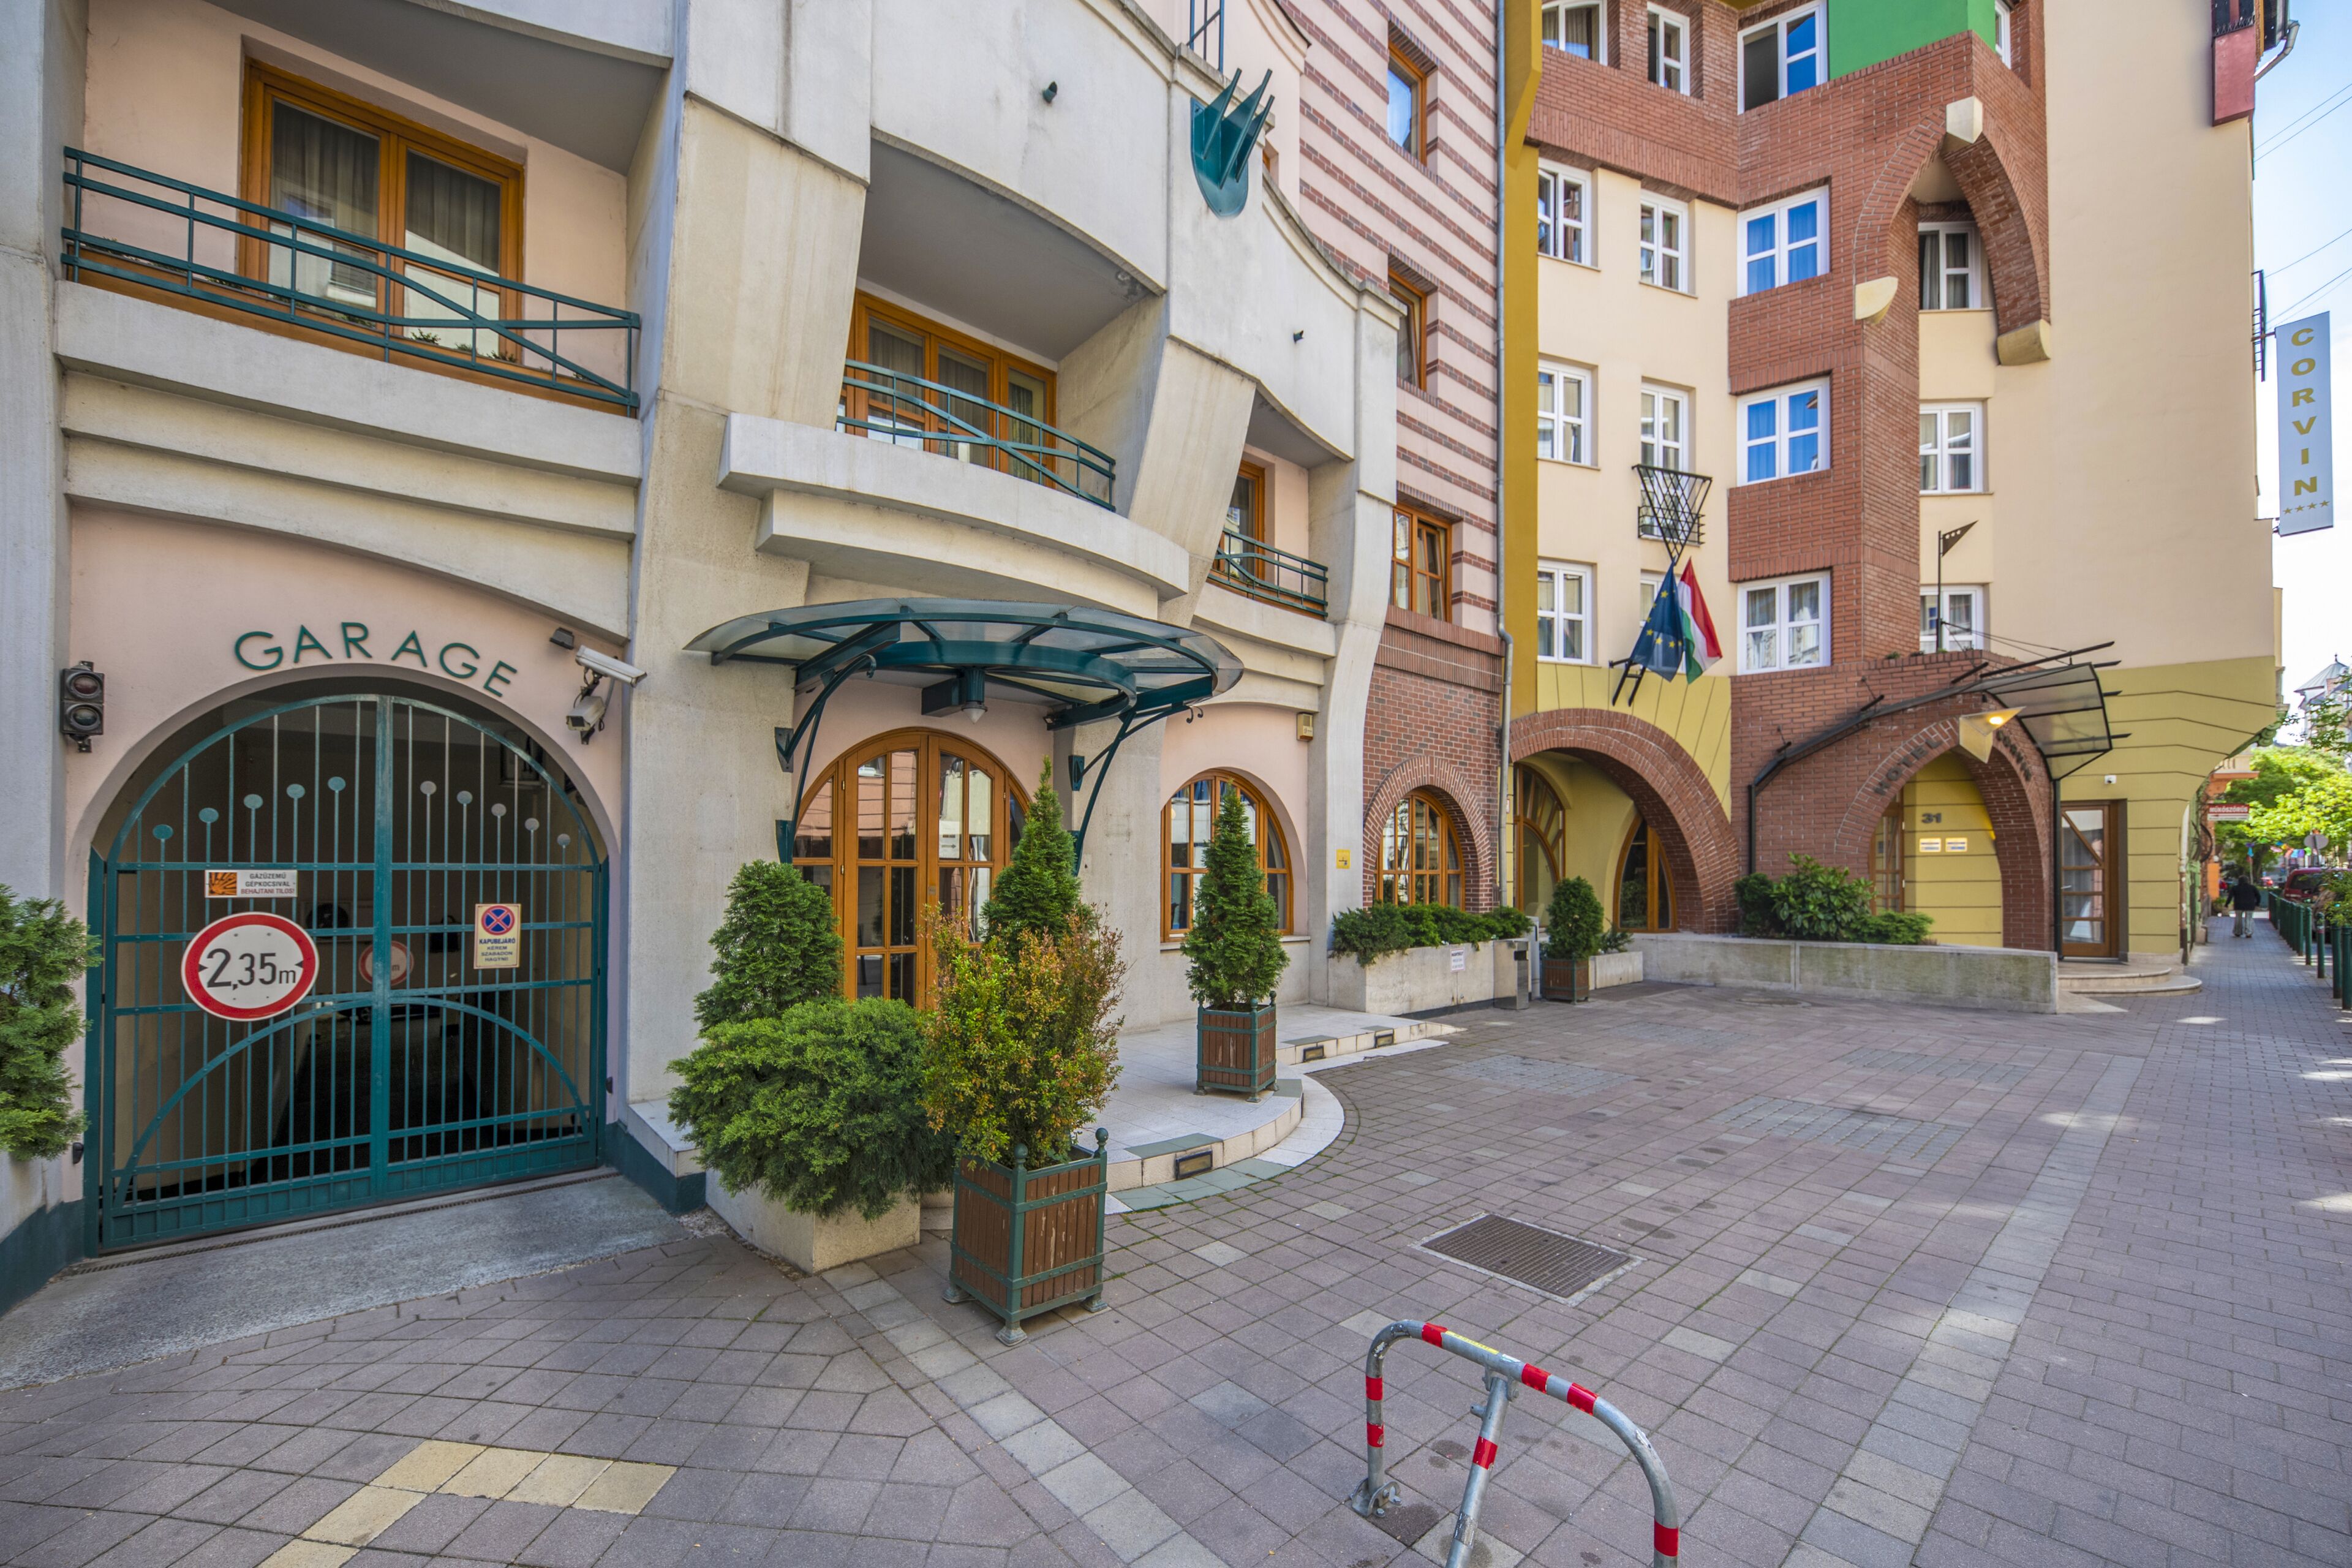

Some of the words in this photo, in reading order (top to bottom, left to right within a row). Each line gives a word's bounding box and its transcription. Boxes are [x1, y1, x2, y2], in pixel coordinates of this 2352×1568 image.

[2290, 327, 2318, 496] CORVIN
[234, 622, 518, 697] GARAGE
[1874, 738, 1943, 796] HOTEL
[1921, 812, 1942, 824] 31
